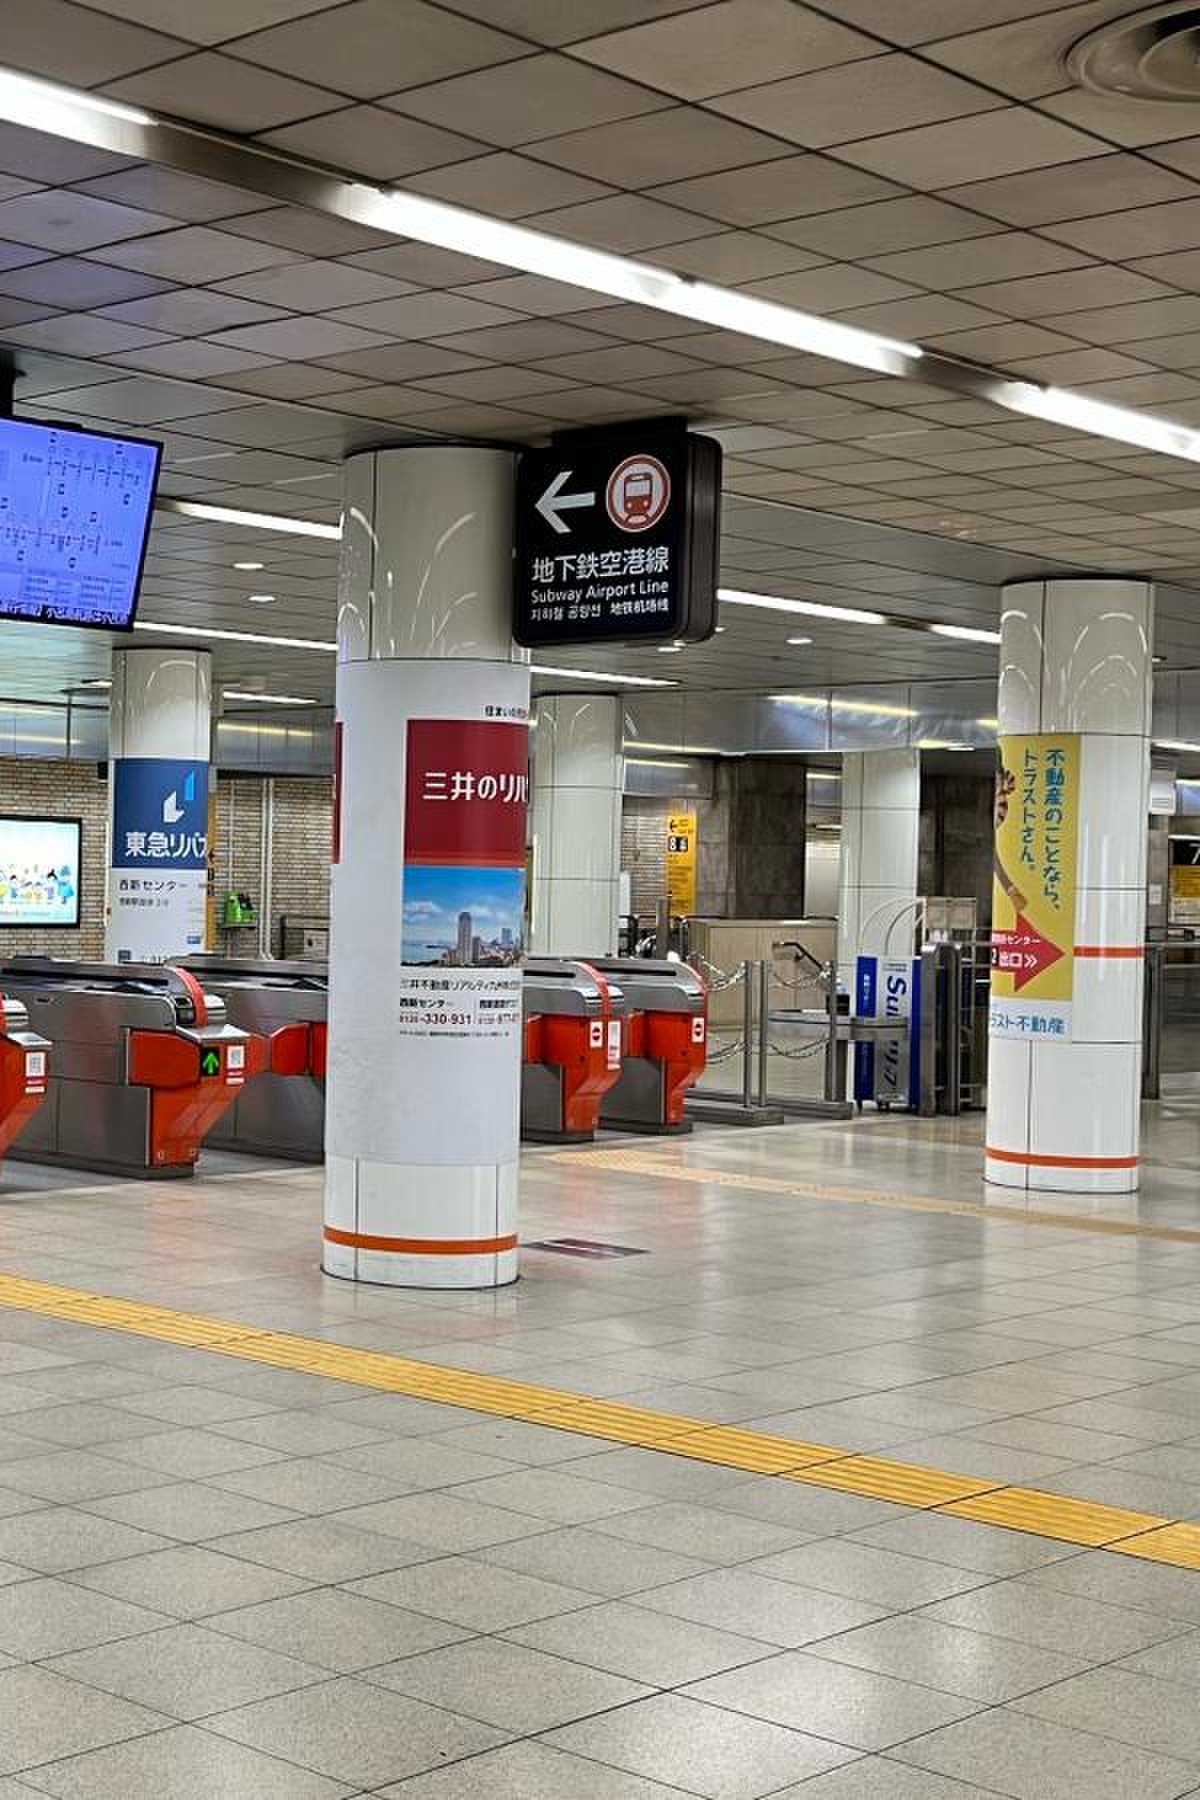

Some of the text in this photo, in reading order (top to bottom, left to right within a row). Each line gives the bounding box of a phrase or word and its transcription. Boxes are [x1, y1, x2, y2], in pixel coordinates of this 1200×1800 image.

[531, 546, 669, 583] 地下鉄空港線
[531, 579, 669, 604] Subway Airport Line
[423, 771, 529, 803] 三井のリハ
[1021, 749, 1037, 870] トラストさん。
[1044, 749, 1065, 910] 不動産のことなら、
